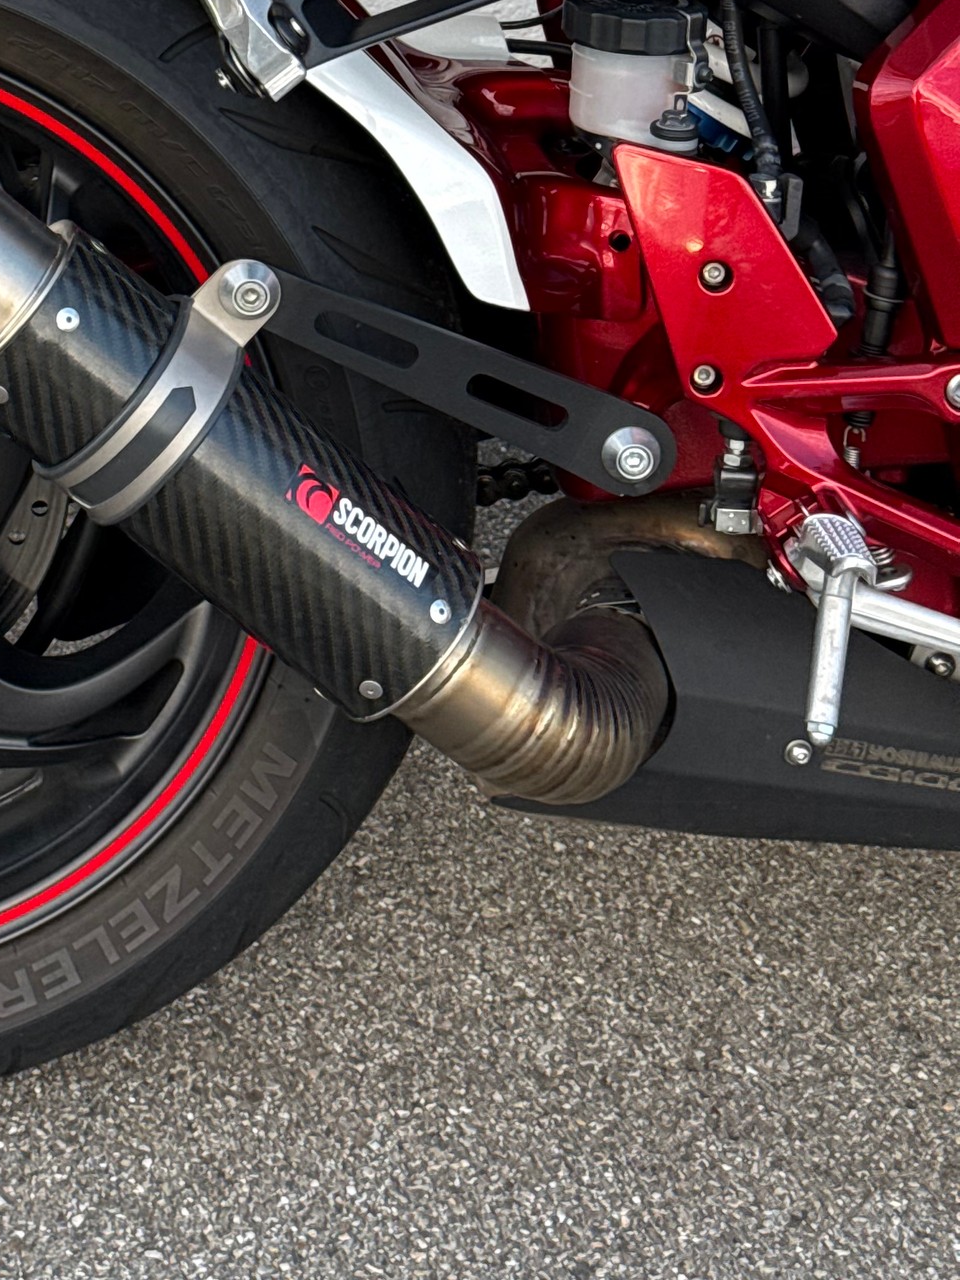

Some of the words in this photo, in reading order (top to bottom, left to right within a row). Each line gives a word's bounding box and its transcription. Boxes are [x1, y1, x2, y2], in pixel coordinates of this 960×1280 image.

[326, 523, 345, 542] RED
[345, 539, 382, 569] POWER
[333, 497, 430, 589] SCORPION
